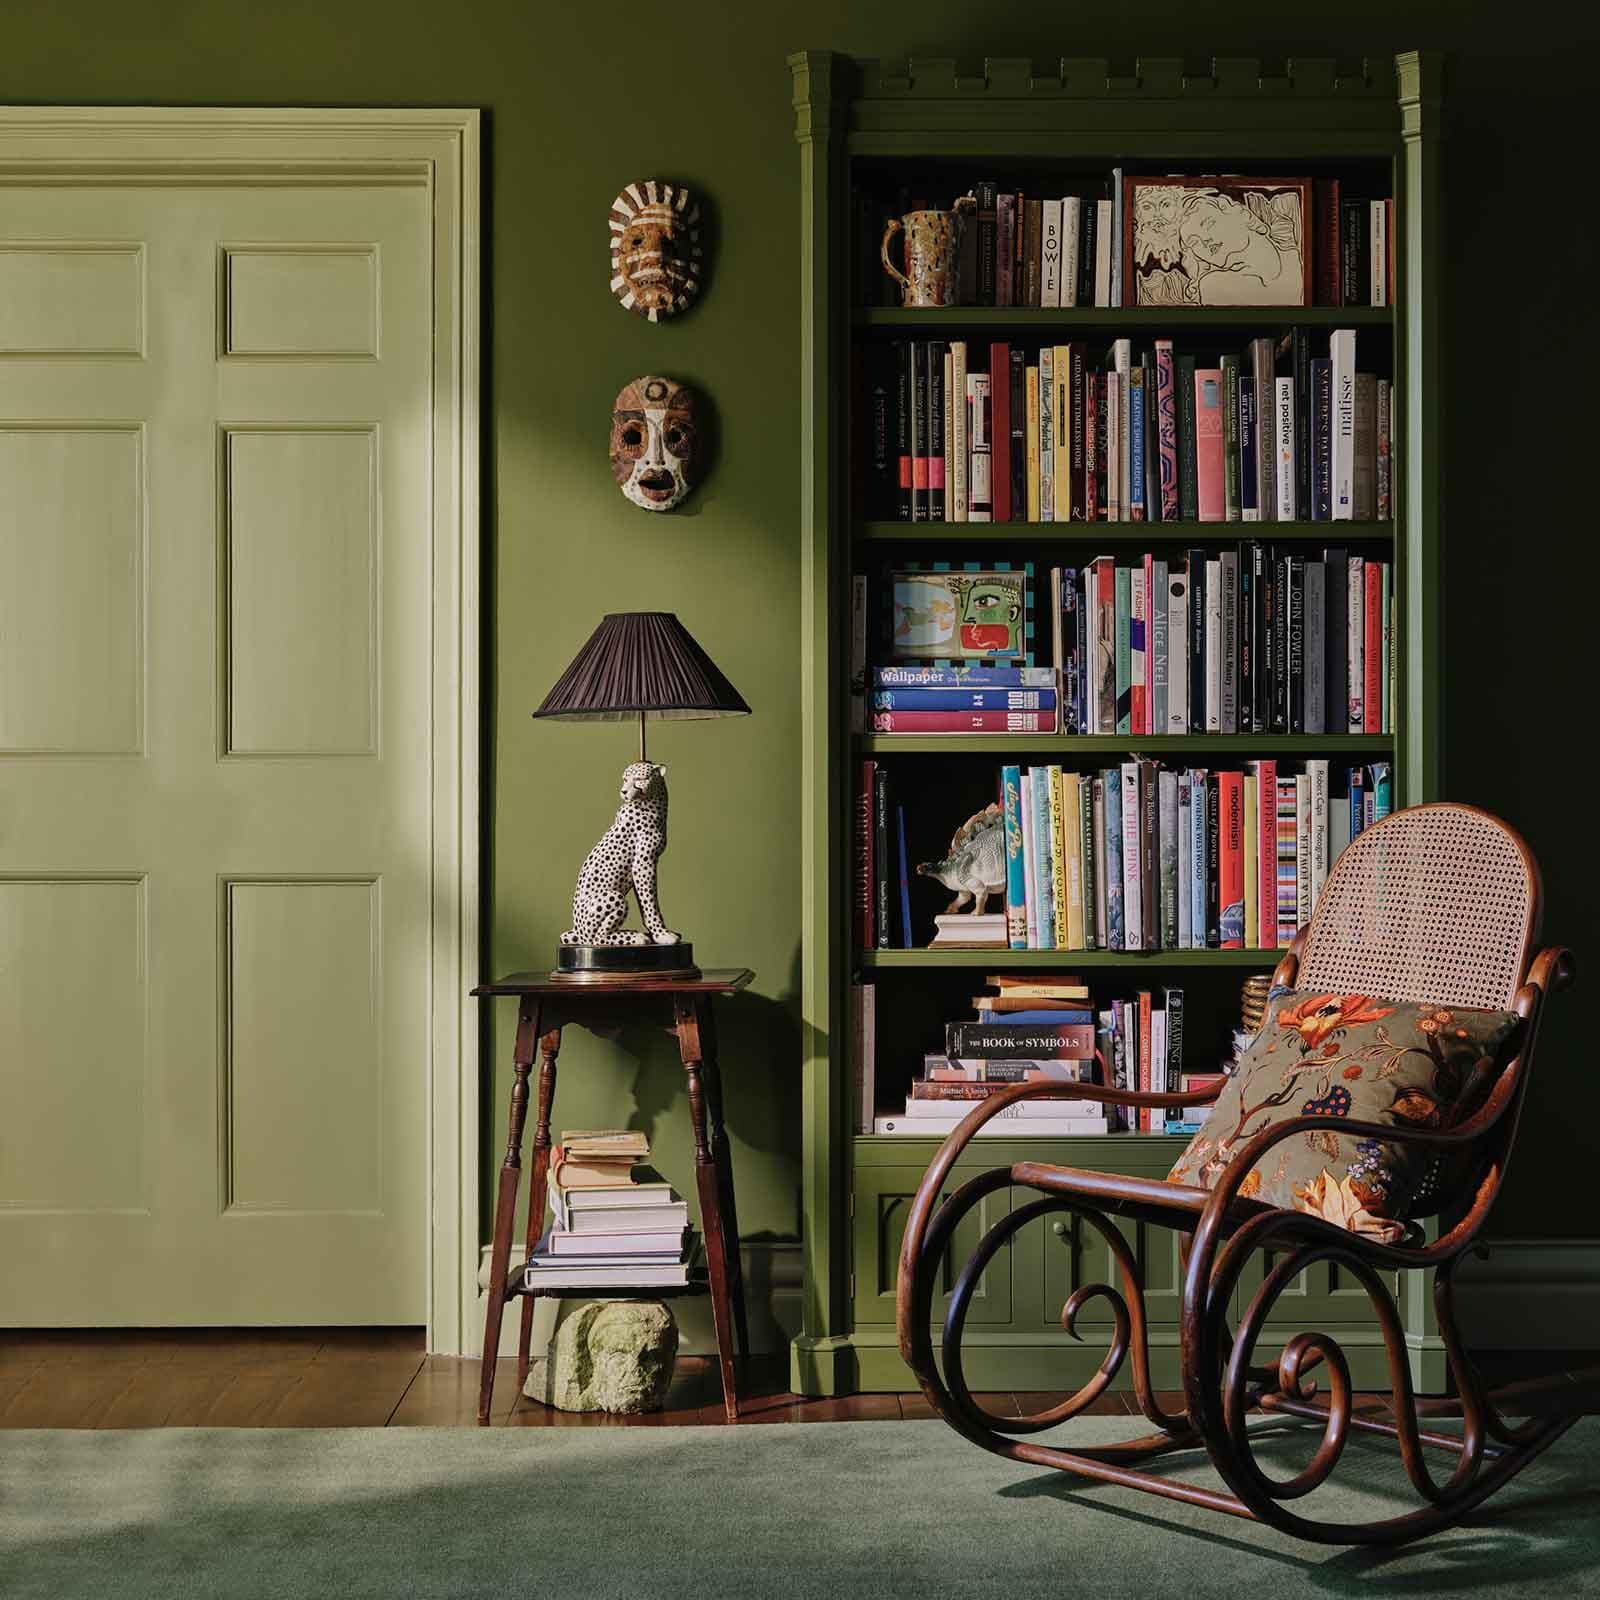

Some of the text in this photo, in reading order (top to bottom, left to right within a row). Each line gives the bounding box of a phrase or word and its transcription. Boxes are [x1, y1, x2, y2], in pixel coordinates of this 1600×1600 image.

[1045, 225, 1058, 291] BOWIE
[1280, 384, 1292, 444] net positive
[1338, 376, 1352, 437] matisse
[1134, 390, 1142, 487] CREATIVE SHRUB GARDEN
[1319, 368, 1329, 496] NATURE'S PALETTE
[1086, 444, 1096, 472] design
[1226, 568, 1234, 592] KERRY
[1226, 593, 1234, 616] JAMES
[1226, 619, 1234, 658] MARSHALL
[1292, 584, 1302, 675] JOHN FOWLER
[880, 670, 944, 684] Wallpaper
[1008, 691, 1024, 710] 100
[1008, 712, 1023, 732] 100
[1144, 783, 1154, 800] Billy
[1264, 768, 1272, 786] JAY
[1007, 782, 1019, 813] Story
[1210, 787, 1218, 816] QUILTS
[1264, 788, 1272, 833] JEFFERS
[1127, 790, 1137, 882] IN THE PINK
[1231, 786, 1240, 850] modernism
[856, 793, 869, 913] MORE IS MORE
[1008, 826, 1022, 860] Pop
[1052, 769, 1065, 944] SLIGHTLY SCENTED
[1210, 828, 1218, 868] PROVENCE
[1300, 834, 1309, 880] FOWLER
[1316, 825, 1325, 870] Photographs
[1300, 883, 1309, 891] &
[982, 1038, 1015, 1048] BOOK
[1026, 1038, 1080, 1048] SYMBOLS
[1170, 1010, 1182, 1064] DRAWING
[970, 1088, 988, 1096] Smith
